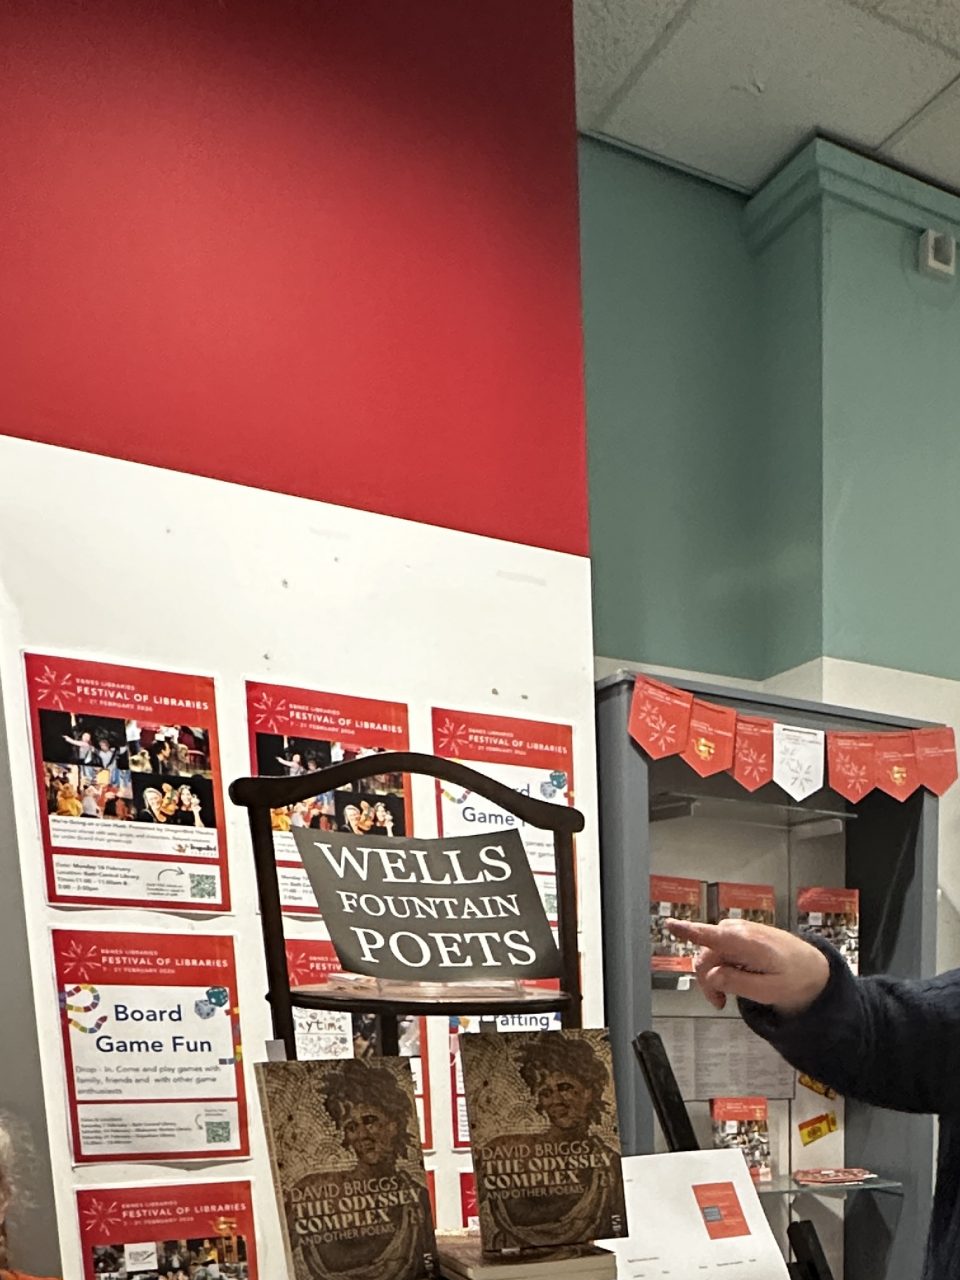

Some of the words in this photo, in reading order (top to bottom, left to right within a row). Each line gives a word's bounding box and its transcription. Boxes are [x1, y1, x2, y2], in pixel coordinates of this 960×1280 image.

[76, 686, 130, 700] FESTIVAL
[133, 693, 149, 703] OF
[153, 696, 209, 711] LIBRARIES
[289, 710, 335, 725] FESTIVAL
[337, 717, 352, 726] OF
[355, 720, 403, 734] LIBRARIES
[468, 734, 509, 747] FESTIVAL
[512, 739, 524, 748] OF
[526, 742, 568, 754] LIBRARIES
[462, 806, 515, 826] Game
[313, 842, 512, 885] WELLS
[336, 890, 522, 920] FOUNTAIN
[350, 926, 537, 968] POETS
[102, 956, 153, 966] FESTIVAL
[156, 957, 172, 966] OF
[174, 958, 228, 968] LIBRARIES
[310, 962, 341, 971] FESTIV
[114, 1004, 182, 1022] Board
[501, 1013, 550, 1030] afting
[96, 1035, 168, 1053] Game
[172, 1036, 212, 1053] Fun
[116, 1065, 140, 1073] Come
[142, 1065, 158, 1073] and
[159, 1065, 175, 1075] play
[178, 1066, 203, 1075] games
[204, 1065, 221, 1073] with
[105, 1076, 133, 1084] friends
[134, 1076, 150, 1084] and
[154, 1076, 171, 1084] with
[195, 1077, 217, 1085] game
[481, 1145, 530, 1160] DAVID
[534, 1140, 590, 1157] BRIGGS
[482, 1159, 525, 1176] THE
[528, 1152, 614, 1172] ODYSSEY
[291, 1183, 342, 1202] DAVID
[344, 1176, 400, 1196] BRIGGS
[484, 1169, 580, 1191] COMPLEX
[486, 1188, 509, 1201] AND
[510, 1187, 548, 1200] OTHER
[549, 1184, 585, 1196] POEMS
[122, 1207, 172, 1219] FESTIVAL
[176, 1206, 191, 1216] OF
[194, 1202, 246, 1214] LIBRARIES
[292, 1199, 337, 1219] THE
[340, 1188, 422, 1214] ODYSSEY
[295, 1208, 391, 1236] COMPLEX
[298, 1232, 322, 1247] AND
[322, 1228, 360, 1244] OTHER
[360, 1224, 396, 1239] POEMS
